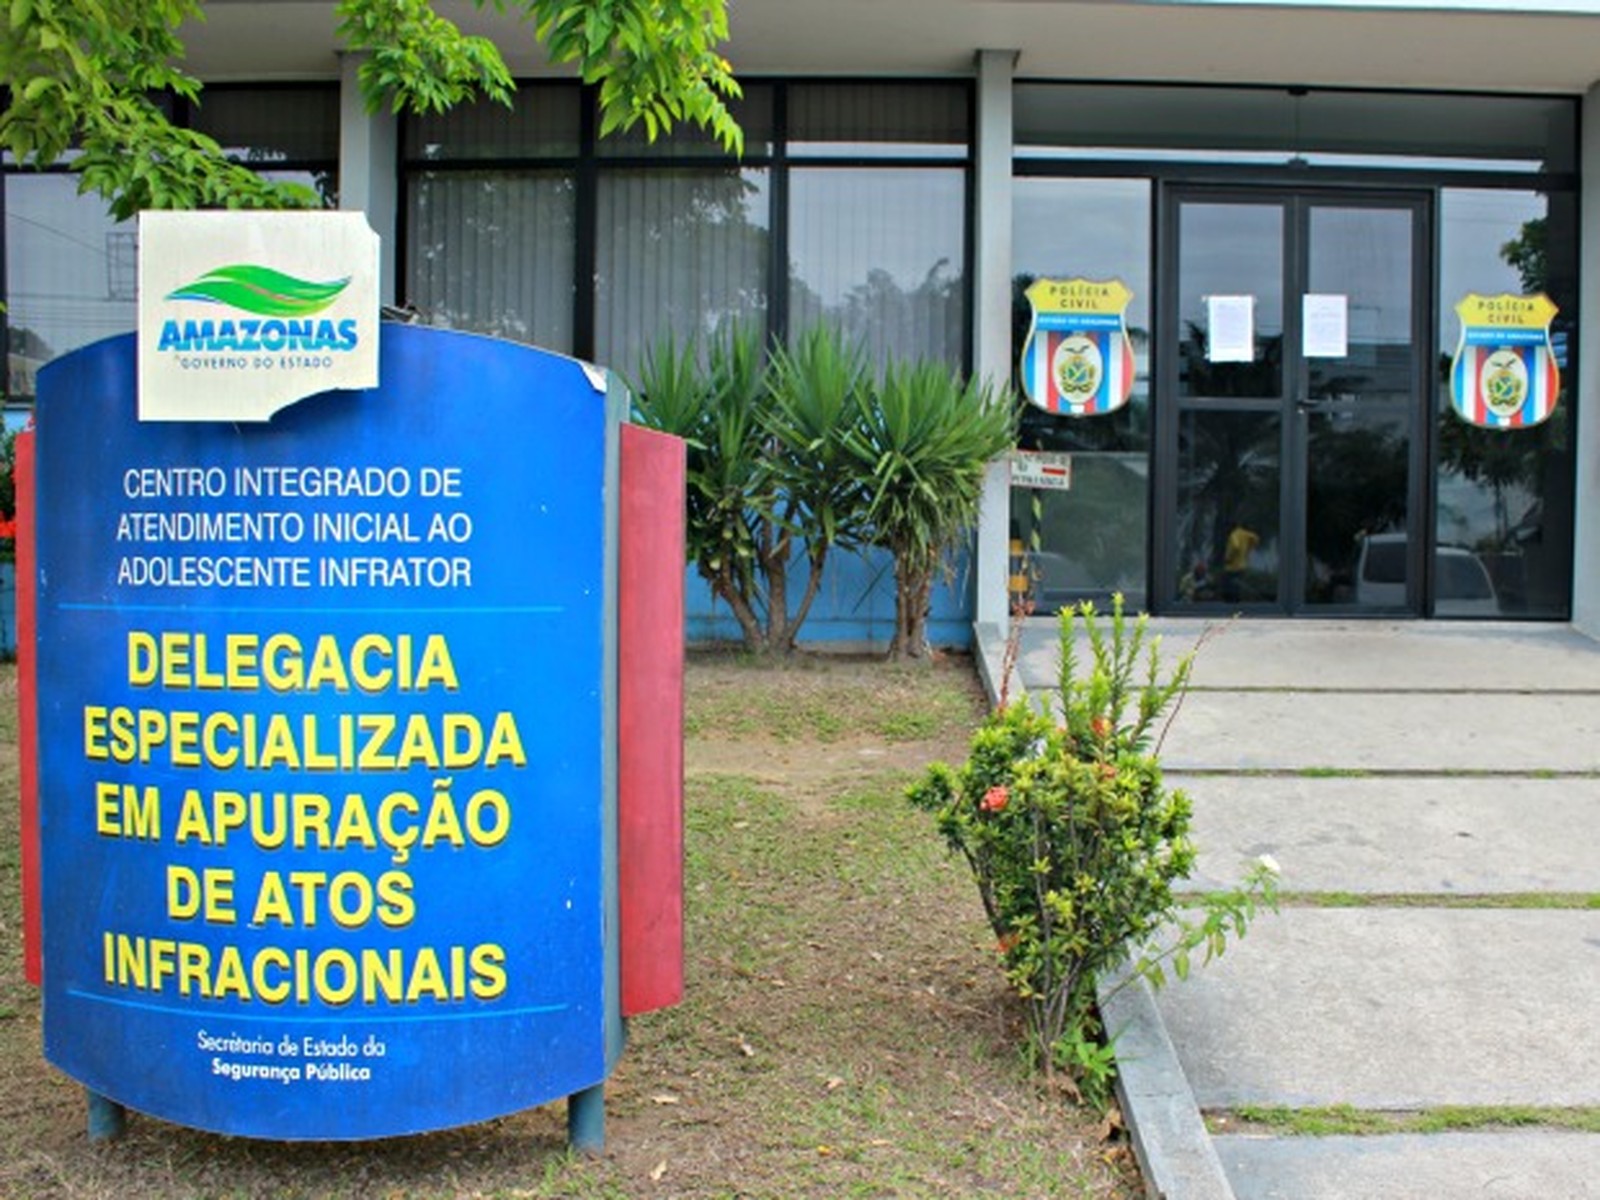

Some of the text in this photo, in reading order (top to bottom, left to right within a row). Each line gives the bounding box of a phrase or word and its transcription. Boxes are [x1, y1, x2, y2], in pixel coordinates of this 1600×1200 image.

[1049, 285, 1110, 297] POLÍCIA
[1060, 298, 1098, 310] CIVIL
[1487, 313, 1525, 325] CIVIL
[157, 319, 358, 351] AMAZONAS
[180, 357, 333, 368] GOVERNO DO ESTADO
[124, 467, 462, 498] CENTRO INTEGRADO DE
[116, 512, 472, 543] ATENDIMENTO INICIAL AO
[117, 556, 472, 588] ADOLESCENTE INFRATOR
[128, 631, 459, 692] DELEGACIA
[84, 705, 526, 770] ESPECIALIZADA
[96, 777, 511, 863] EM APURAÇÃO
[167, 865, 416, 927] DE ATOS
[103, 932, 507, 1003] INFRACIONAIS
[278, 1033, 299, 1056] de
[303, 1034, 358, 1056] Estado
[362, 1034, 386, 1056] da
[212, 1057, 371, 1085] Segurança Pública
